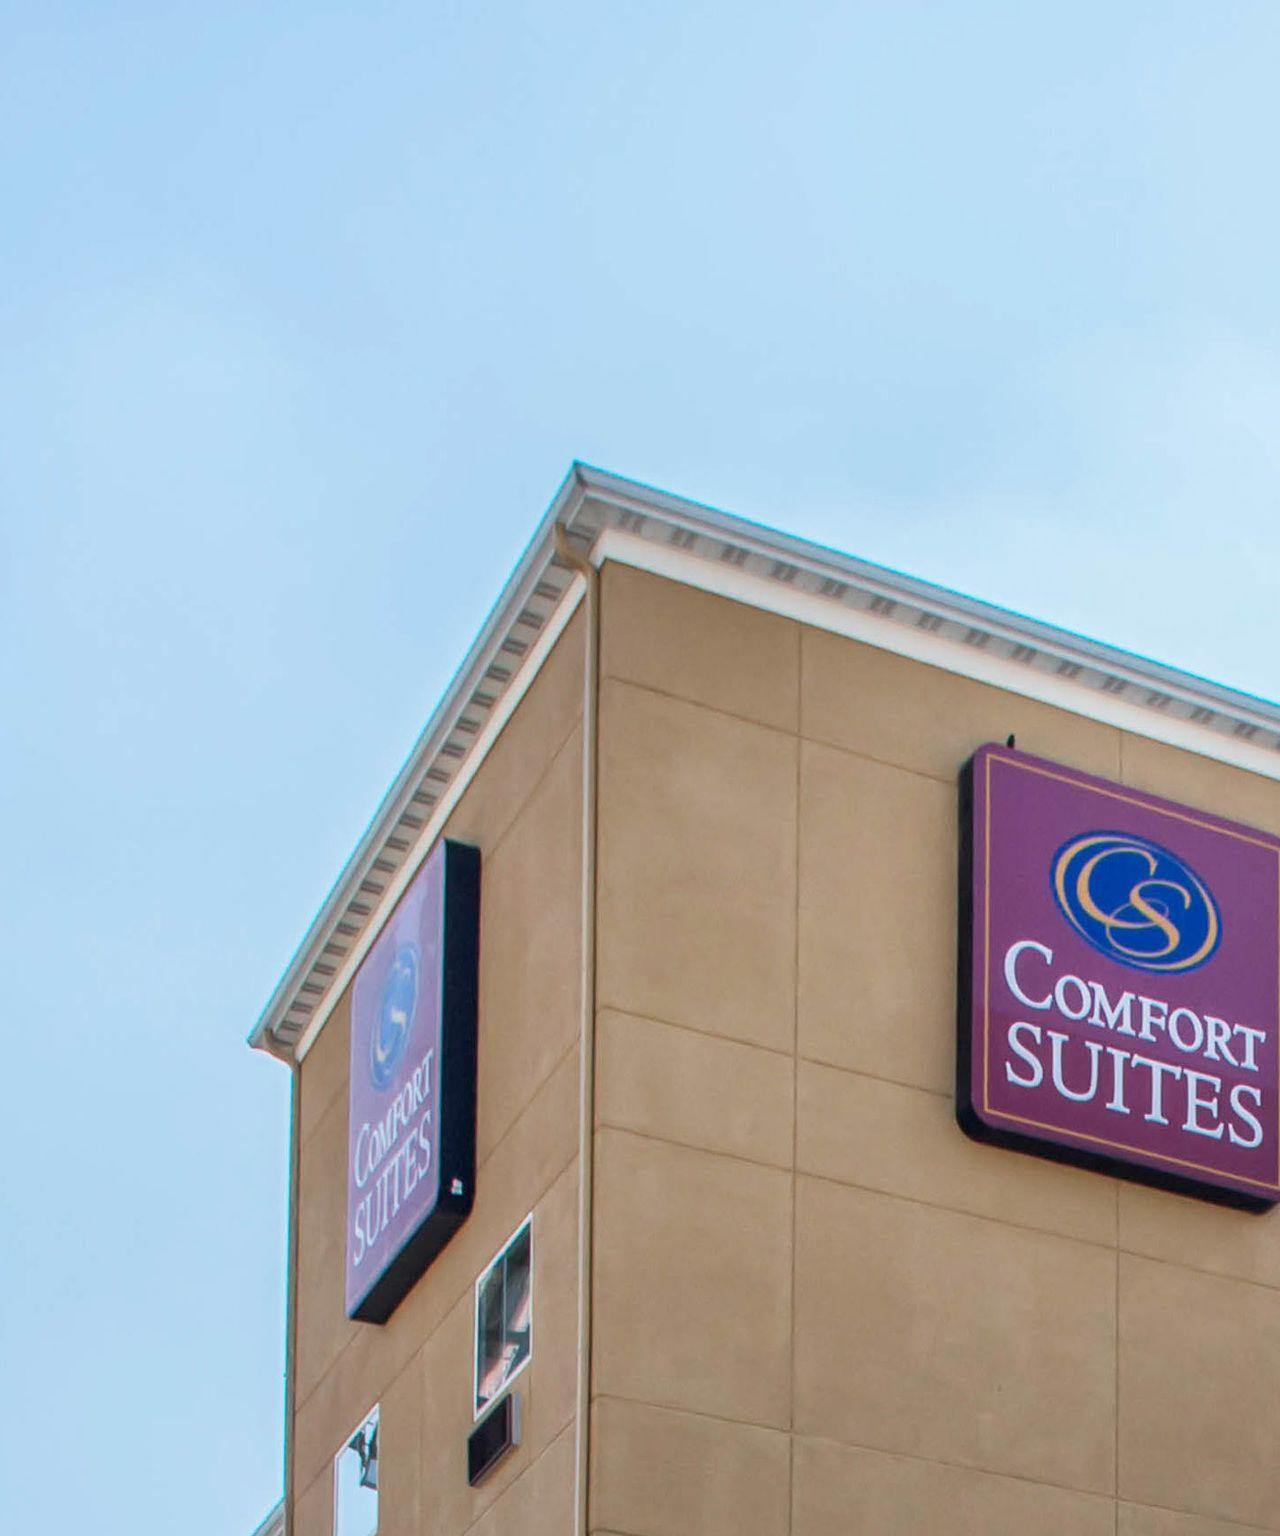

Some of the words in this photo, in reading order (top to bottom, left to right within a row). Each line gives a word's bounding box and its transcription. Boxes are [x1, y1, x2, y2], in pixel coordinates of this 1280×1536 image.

[1003, 940, 1266, 1072] COMFORT
[354, 1047, 434, 1188] COMFORT
[1005, 1021, 1264, 1149] SUITES
[353, 1109, 432, 1267] SUITES
